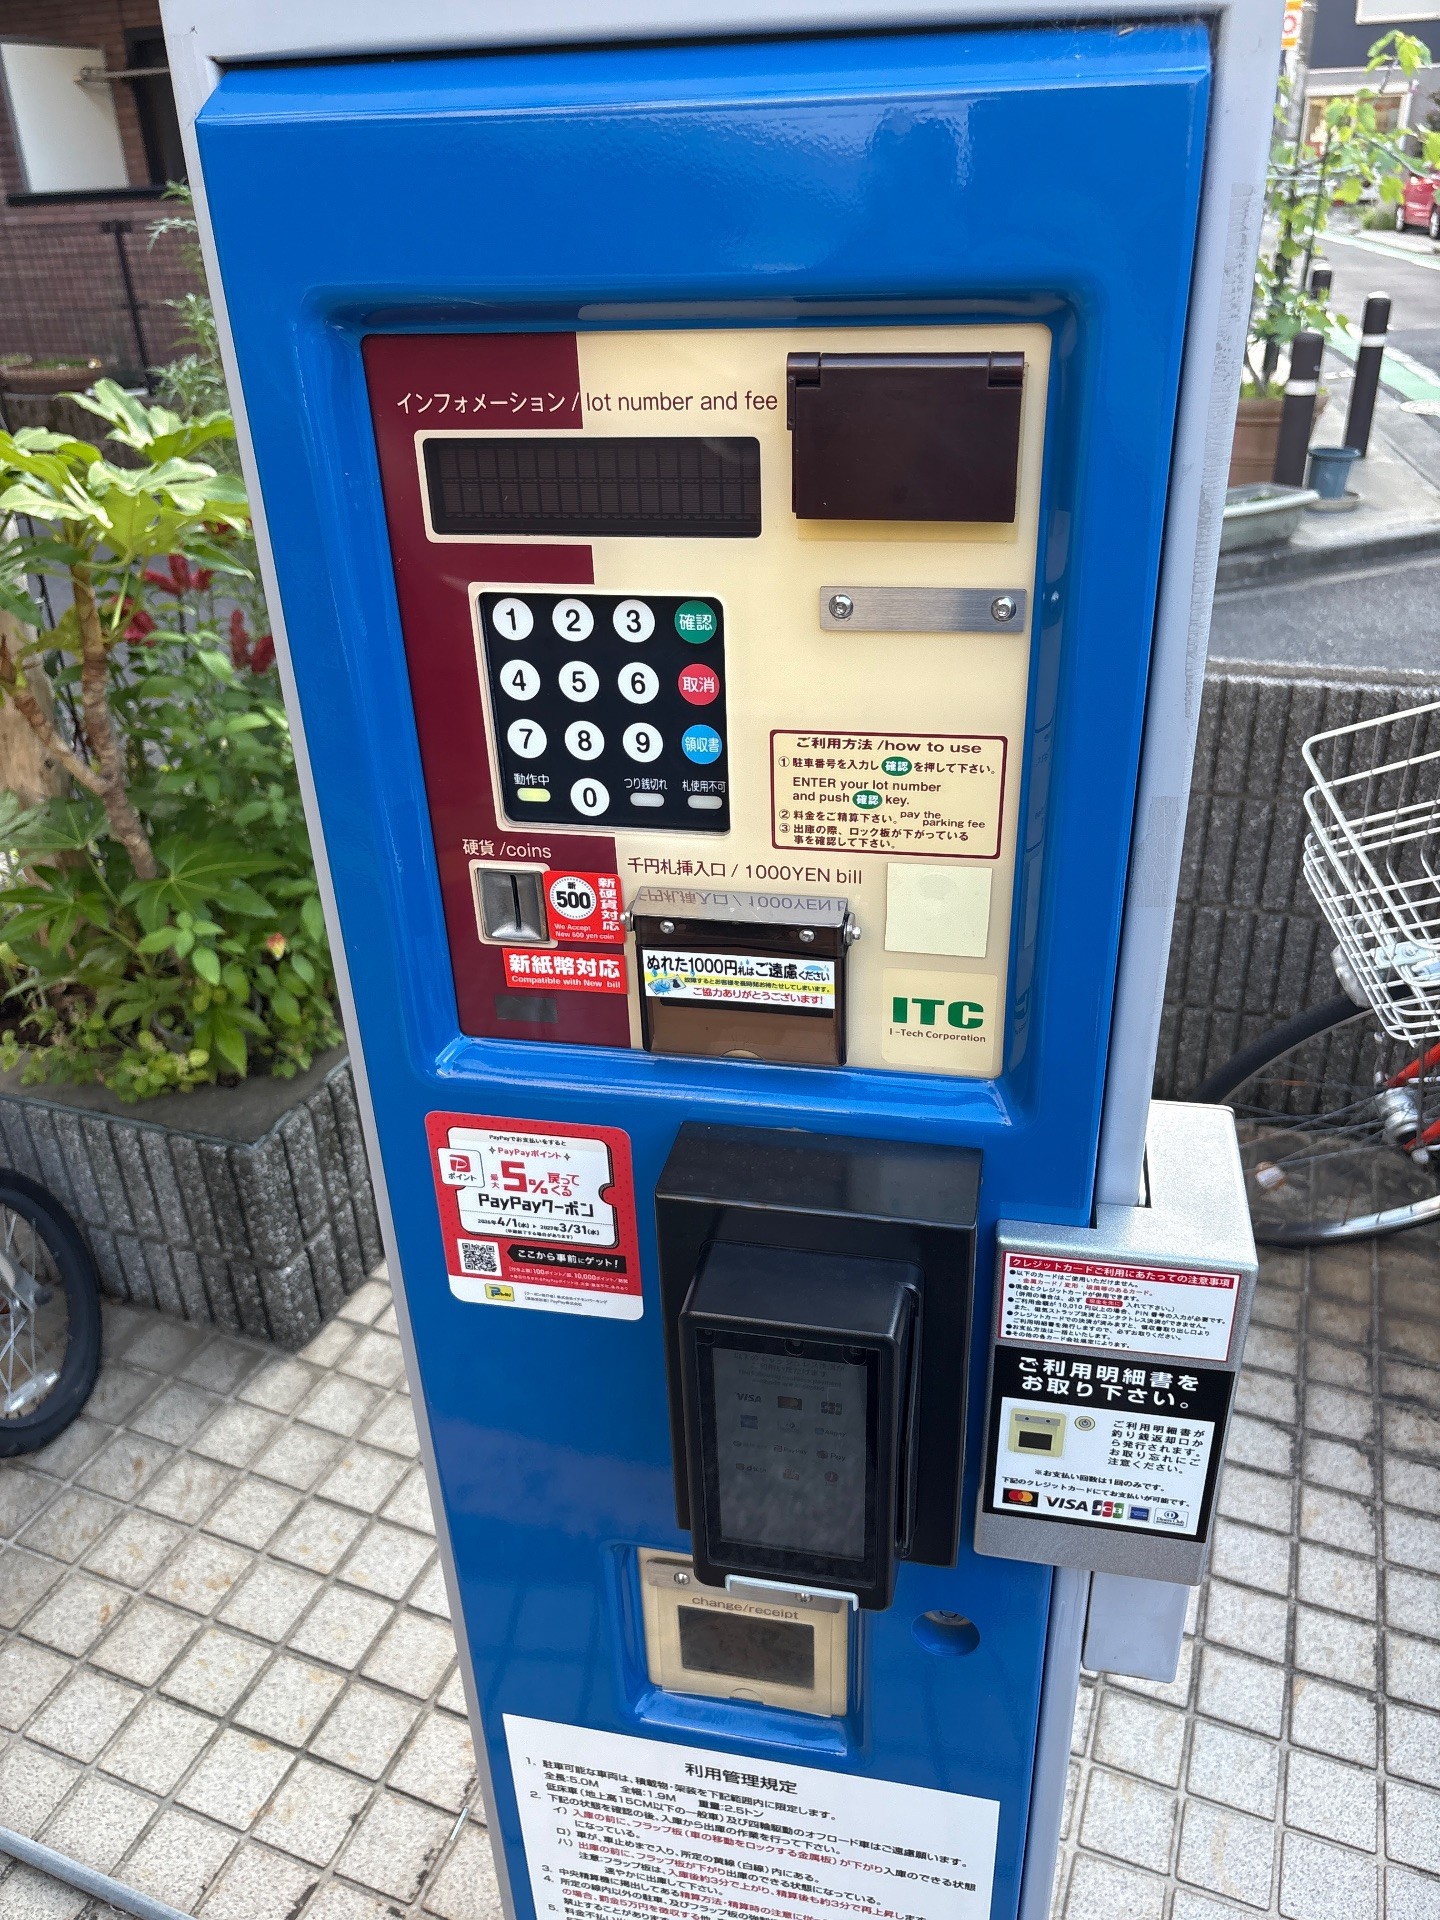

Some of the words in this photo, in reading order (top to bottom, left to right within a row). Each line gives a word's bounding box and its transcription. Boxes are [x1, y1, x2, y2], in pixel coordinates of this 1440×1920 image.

[397, 391, 565, 414] インフォメーション
[587, 392, 611, 411] lot
[618, 393, 693, 411] number
[701, 391, 737, 411] and
[745, 390, 778, 410] fee
[506, 608, 517, 631] 1
[566, 609, 581, 632] 2
[626, 610, 641, 633] 3
[679, 614, 712, 631] 確認
[512, 669, 526, 691] 4
[572, 671, 586, 692] 5
[631, 672, 645, 694] 6
[682, 676, 715, 692] 取消
[519, 728, 533, 749] 7
[577, 730, 592, 751] 8
[635, 731, 650, 753] 9
[685, 737, 719, 753] 領収書
[797, 737, 873, 750] ご利用方法
[927, 742, 944, 753] to
[950, 744, 981, 754] use
[792, 757, 879, 771] 駐車番号を入力し
[884, 761, 908, 772] 確認
[914, 761, 996, 774] を押して下さい。
[514, 773, 550, 786] 動作中
[624, 777, 668, 790] つり銭切れ
[682, 780, 726, 793] 札使用不可
[793, 777, 836, 788] ENTER
[840, 779, 868, 791] your
[873, 780, 889, 790] lot
[892, 781, 941, 792] number
[583, 787, 597, 808] 0
[793, 792, 815, 802] and
[820, 793, 850, 803] push
[856, 794, 880, 805] 確認
[885, 795, 910, 807] key.
[793, 810, 898, 824] 料金をご精算下さい。
[900, 810, 920, 820] pay
[924, 810, 941, 819] the
[923, 818, 964, 829] parking
[967, 819, 985, 828] fee
[462, 839, 495, 856] 硬貨
[794, 835, 896, 849] 事を確認して下さい。
[628, 857, 726, 877] 千円札挿入口
[746, 865, 830, 883] 1000YEN
[836, 869, 862, 884] bill
[568, 882, 576, 890] 新
[556, 891, 591, 909] 500
[597, 877, 620, 932] 新硬貨対応
[509, 954, 620, 978] 新紙幣対応
[512, 976, 561, 986] Compatible
[563, 978, 581, 986] with
[584, 979, 602, 987] New
[607, 980, 620, 989] bill
[893, 997, 984, 1029] ITC
[926, 1031, 985, 1042] Corporation
[497, 1146, 561, 1160] PayPayポイント
[448, 1172, 477, 1182] ポイント
[547, 1172, 580, 1186] 戻って
[550, 1184, 572, 1197] くる
[477, 1192, 594, 1218] PayPayクーポン
[1012, 1258, 1230, 1287] クレジットカードご利用にあたっての注意事項
[1019, 1356, 1199, 1392] ご利用明細書を
[735, 1392, 761, 1403] VISA
[1022, 1375, 1189, 1409] お取り下さい。
[1111, 1428, 1203, 1448] 釣り銭返却口か
[1113, 1419, 1205, 1438] ご利用明細書が
[1108, 1447, 1200, 1466] お取り忘れにご
[1110, 1438, 1201, 1457] ら発行されます。
[1107, 1457, 1184, 1474] 注意ください。
[1001, 1476, 1190, 1507] 下記のクレジットカードにてお支払いが可能です。
[1043, 1495, 1088, 1512] VISA
[1091, 1499, 1124, 1519] JCB
[692, 1596, 799, 1620] change/receipt
[683, 1761, 798, 1795] 利用管理規定
[573, 1819, 641, 1839] になっている。
[603, 1866, 724, 1896] 速やかに出庫して下さい。
